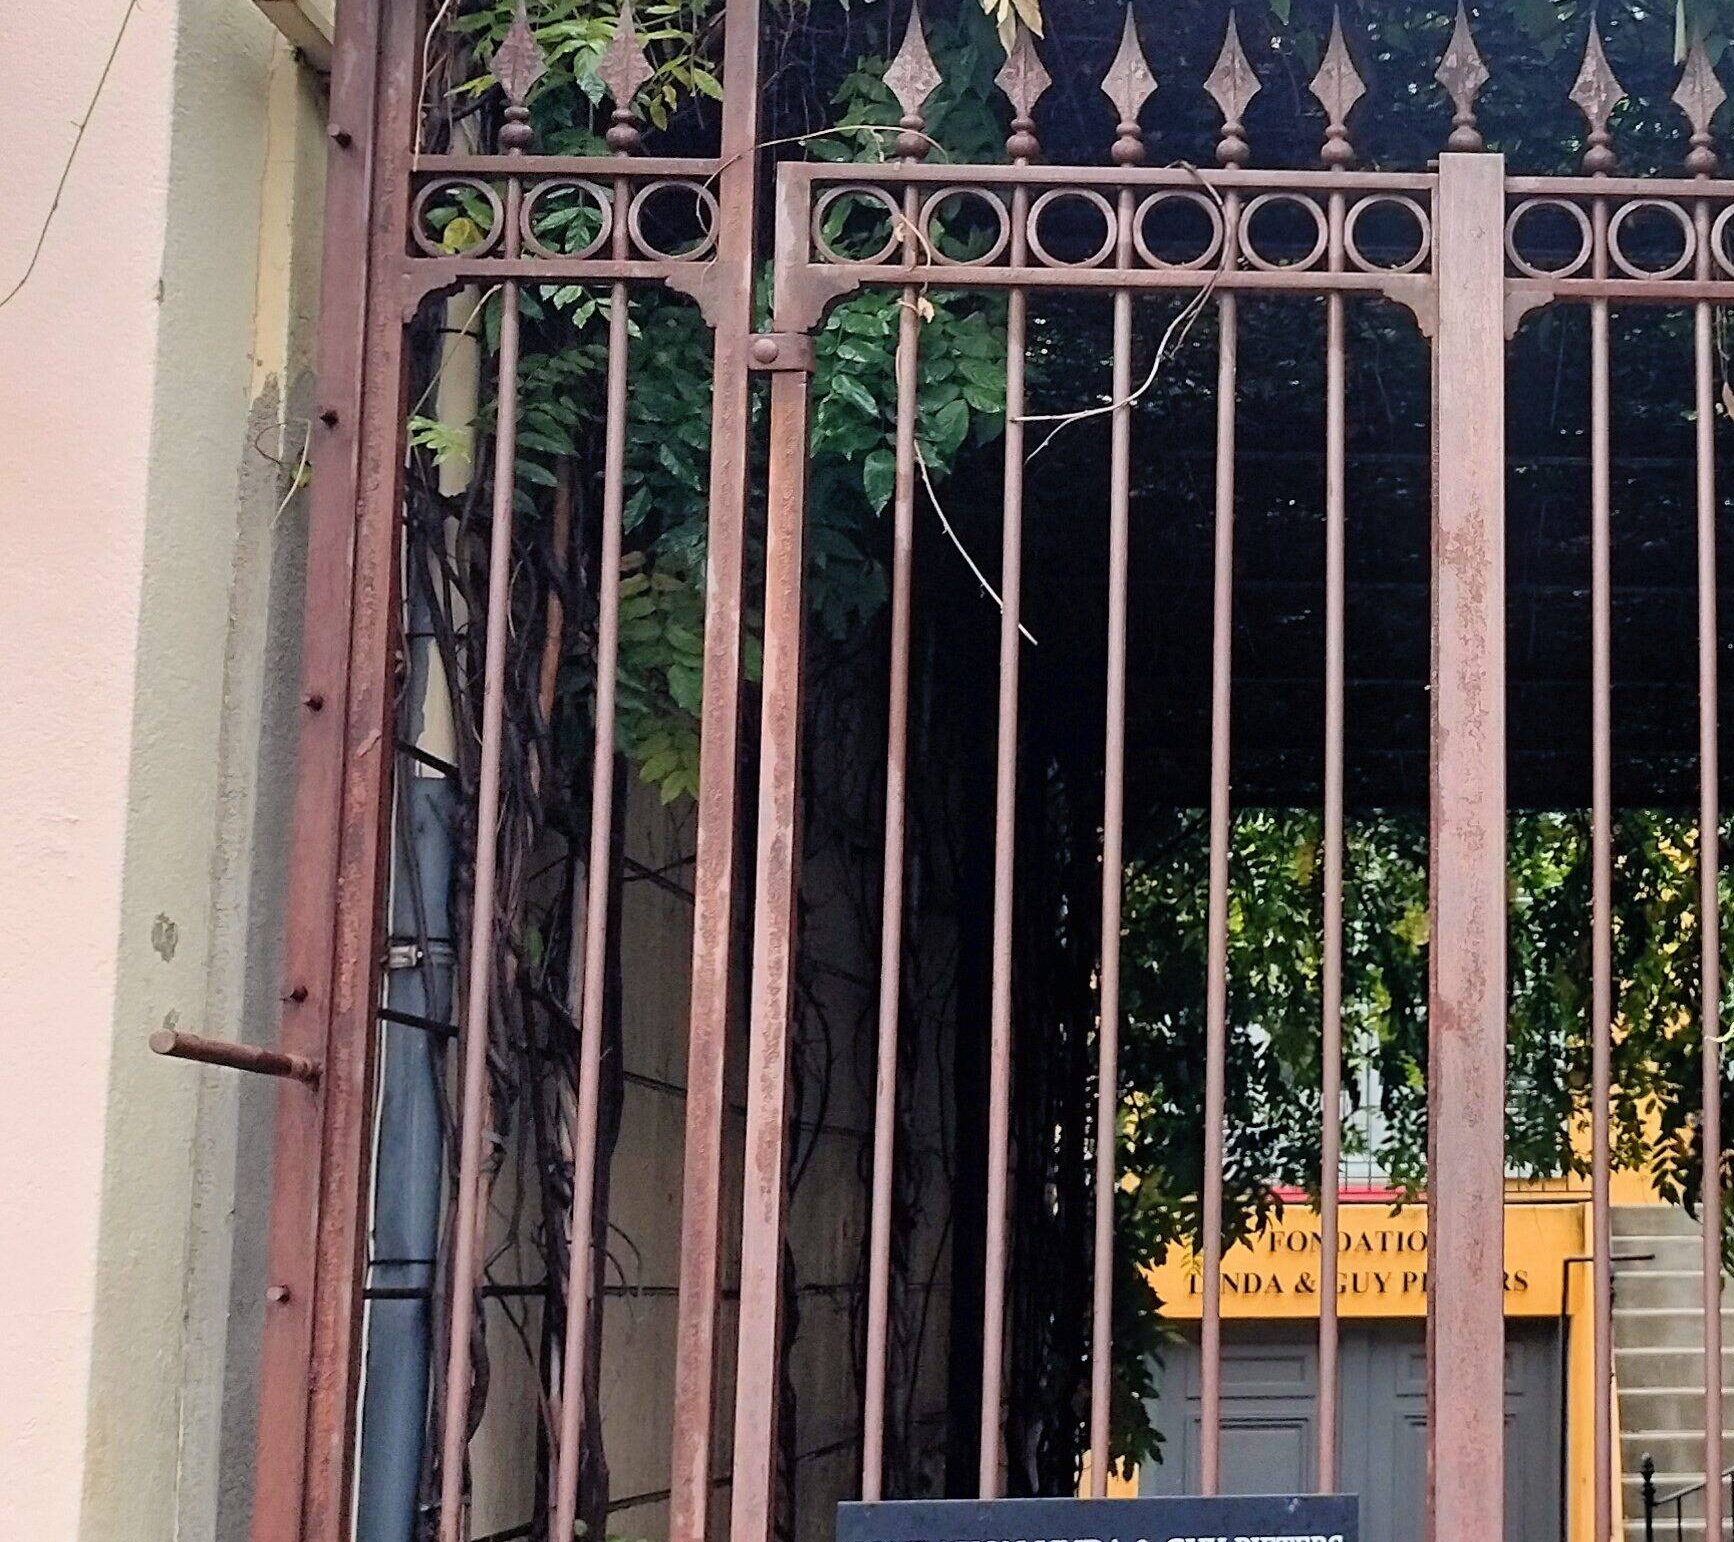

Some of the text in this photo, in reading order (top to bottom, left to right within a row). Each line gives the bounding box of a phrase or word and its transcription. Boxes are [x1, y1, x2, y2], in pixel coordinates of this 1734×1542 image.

[1268, 1230, 1429, 1254] FONDATIO
[1189, 1272, 1284, 1294] LNDA
[1294, 1271, 1317, 1294] &
[1336, 1271, 1392, 1294] GUY
